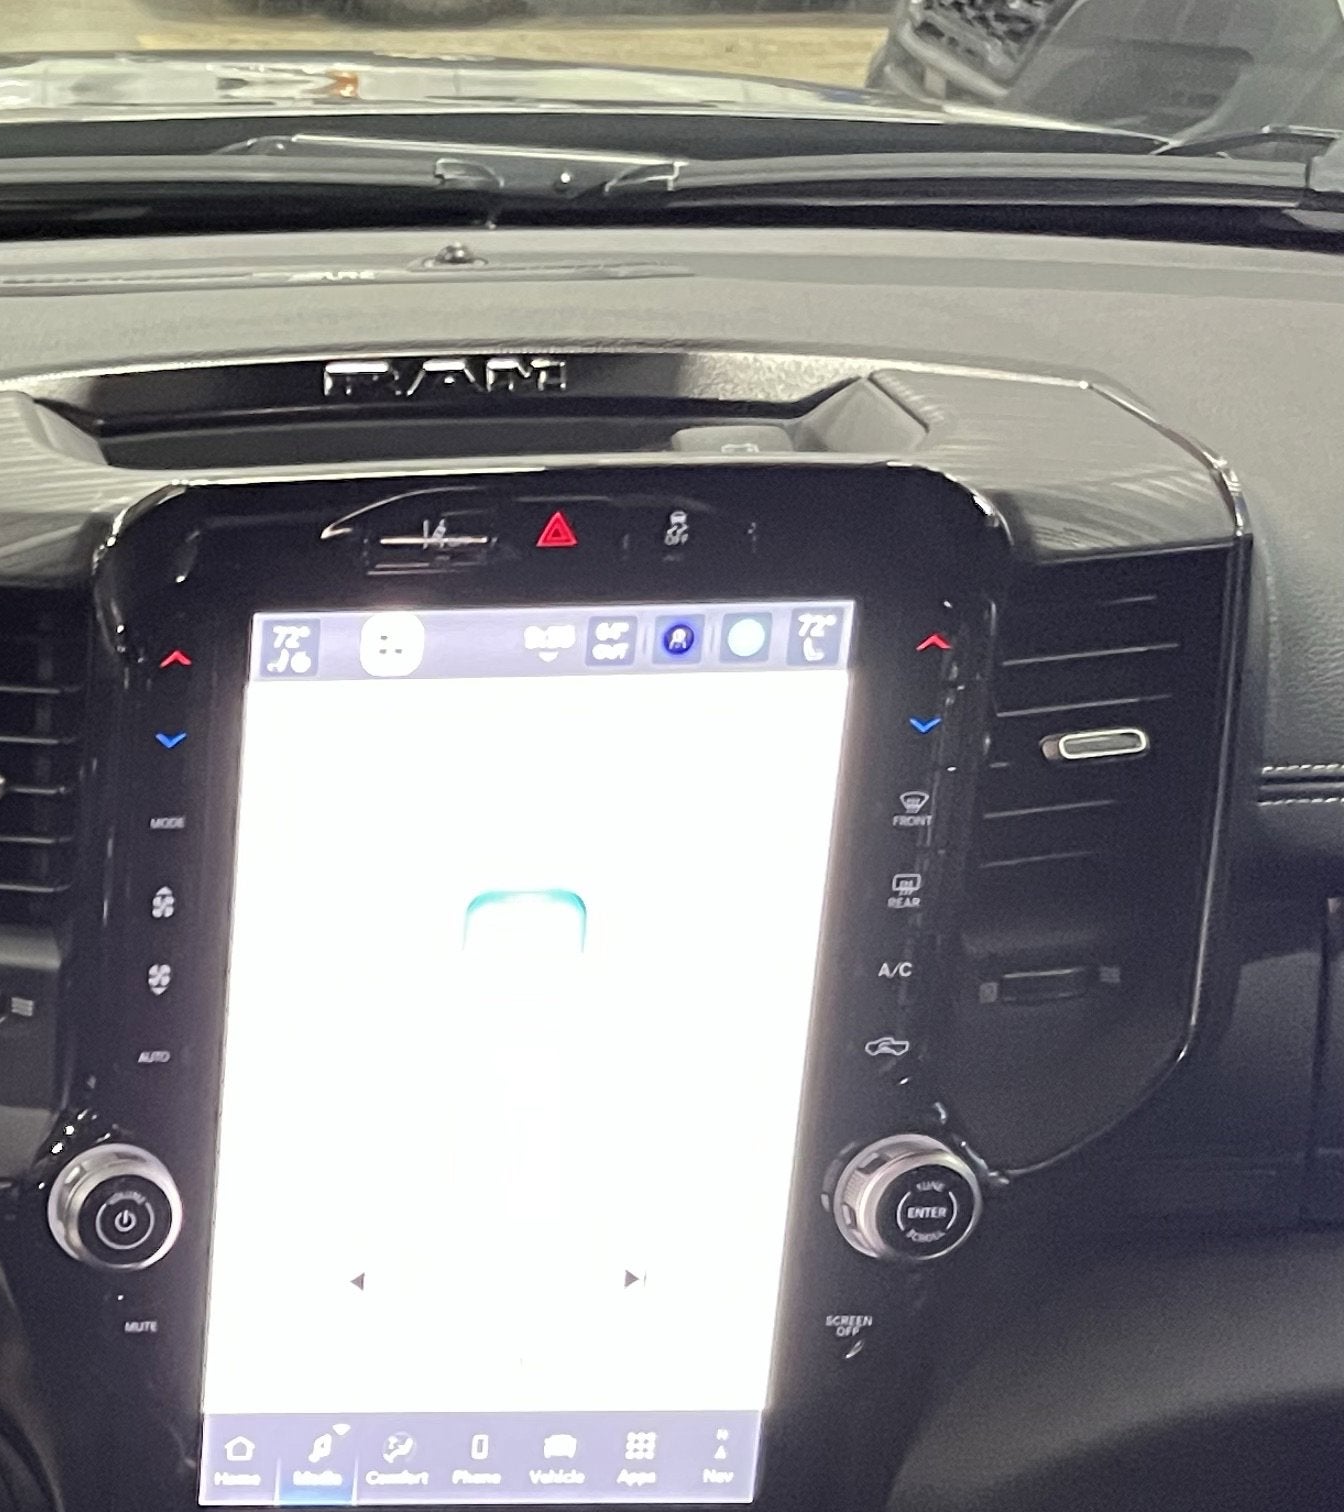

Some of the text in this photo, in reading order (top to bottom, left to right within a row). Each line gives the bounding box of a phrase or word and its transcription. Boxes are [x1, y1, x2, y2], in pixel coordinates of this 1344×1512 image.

[323, 359, 568, 397] RAM
[892, 815, 933, 827] FRONT
[878, 961, 913, 978] A/C
[907, 1206, 948, 1219] ENTER
[124, 1321, 158, 1333] MUTE
[825, 1315, 873, 1327] SCREEN
[836, 1326, 861, 1337] OFF
[528, 1469, 585, 1485] Vehicle
[702, 1468, 734, 1484] Nav
